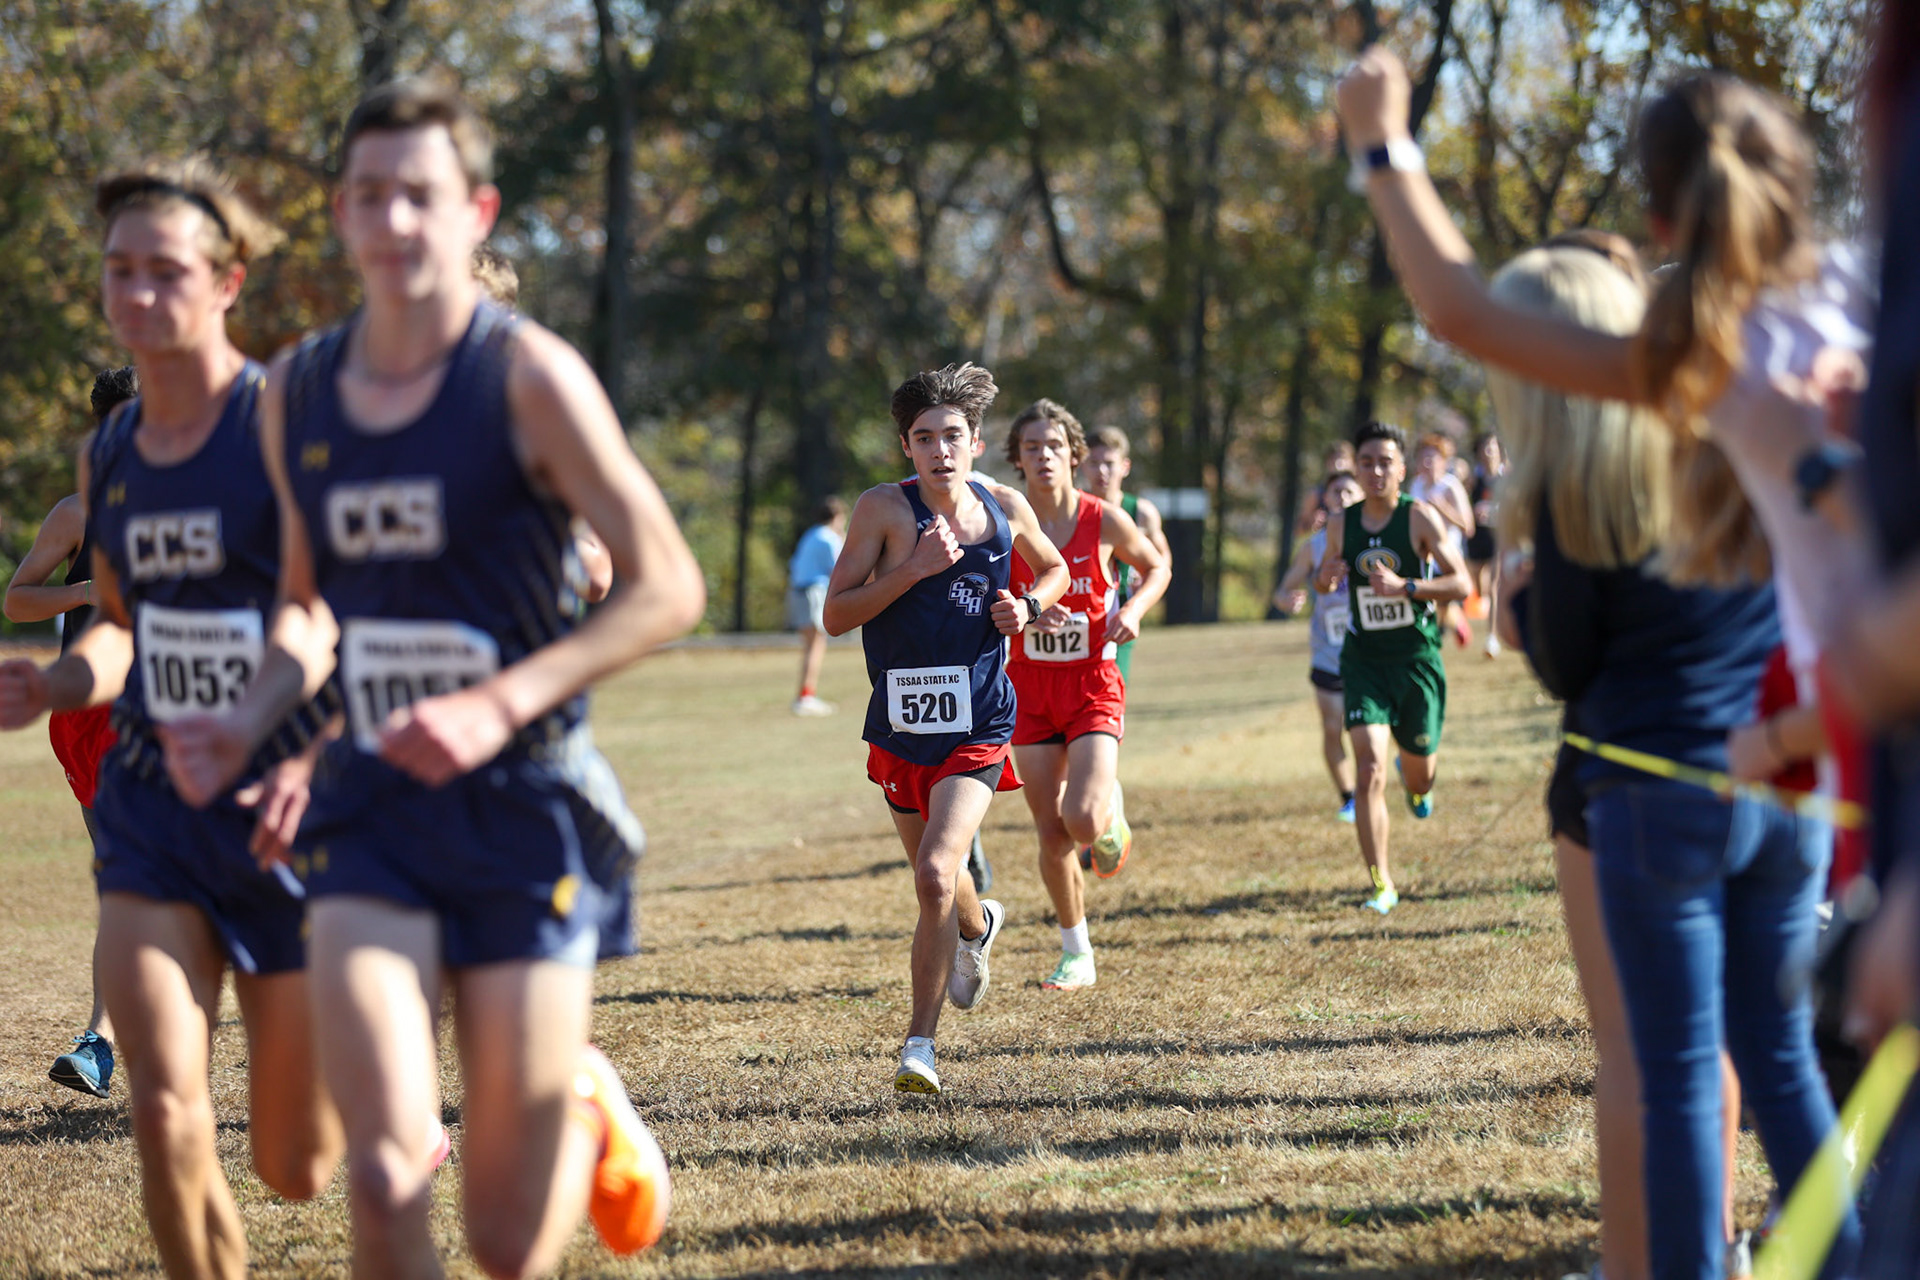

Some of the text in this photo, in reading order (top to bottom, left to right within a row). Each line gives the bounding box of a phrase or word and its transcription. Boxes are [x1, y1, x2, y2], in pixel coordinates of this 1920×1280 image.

[325, 477, 447, 560] CCS
[126, 510, 226, 580] CCS
[950, 581, 982, 614] SBA
[1366, 602, 1405, 622] 1037
[1031, 631, 1082, 653] 1012
[896, 674, 960, 687] TSSAA STATE XC
[901, 691, 957, 725] 520
